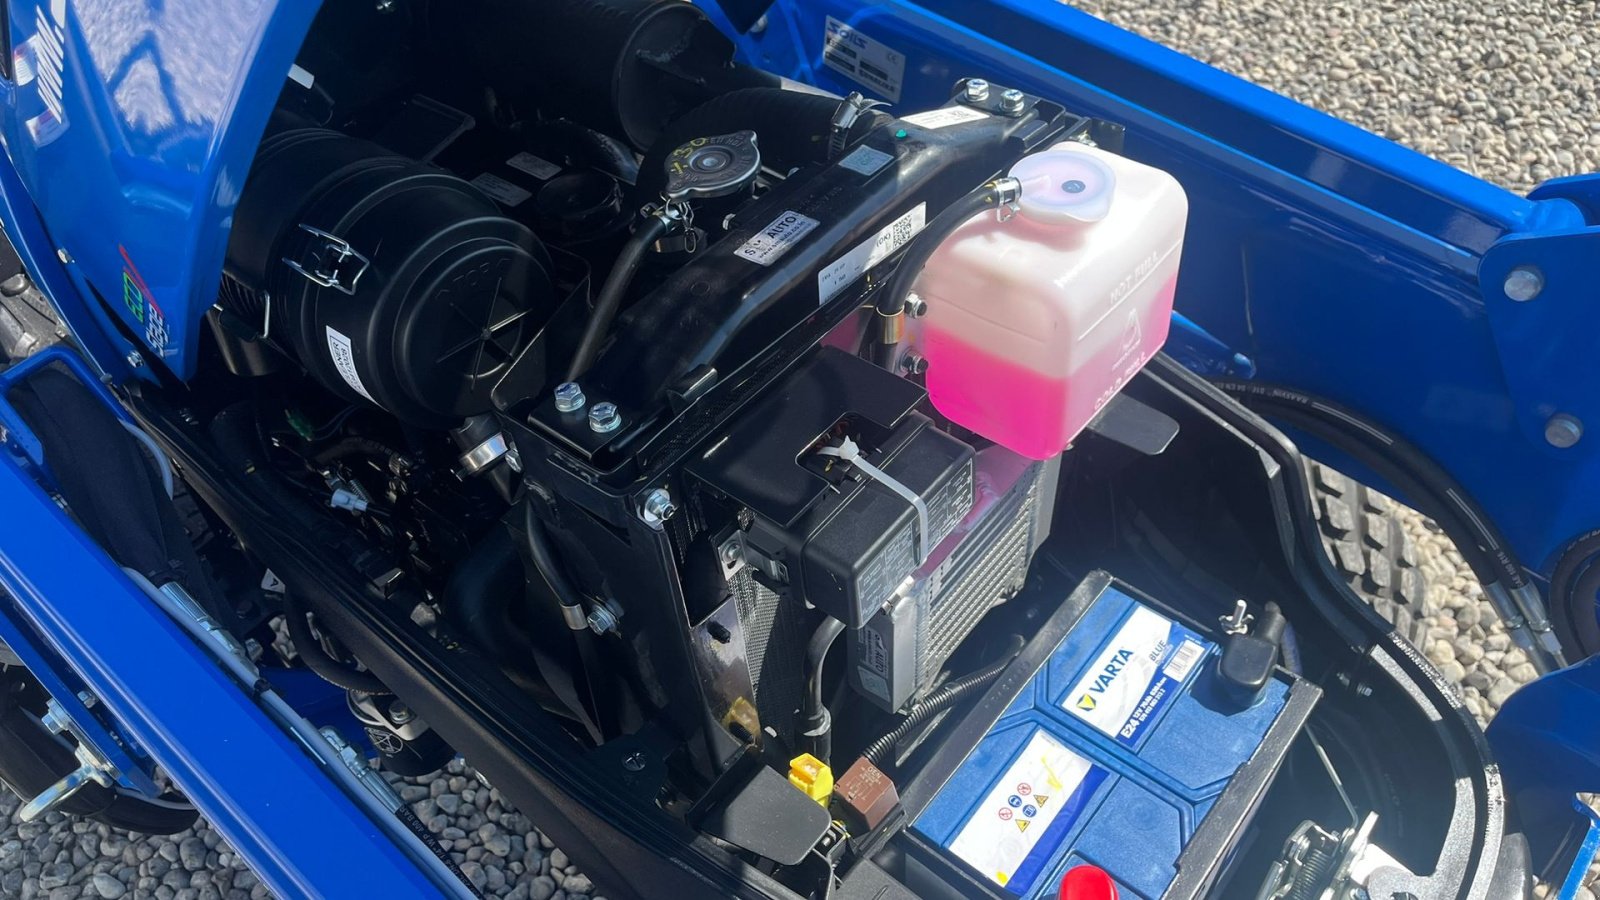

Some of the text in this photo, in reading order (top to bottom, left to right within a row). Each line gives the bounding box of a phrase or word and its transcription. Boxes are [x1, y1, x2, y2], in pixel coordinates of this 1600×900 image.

[768, 216, 797, 240] AUTO
[1149, 639, 1167, 663] BLUE
[1089, 648, 1133, 694] VARTA
[1120, 719, 1140, 739] E24
